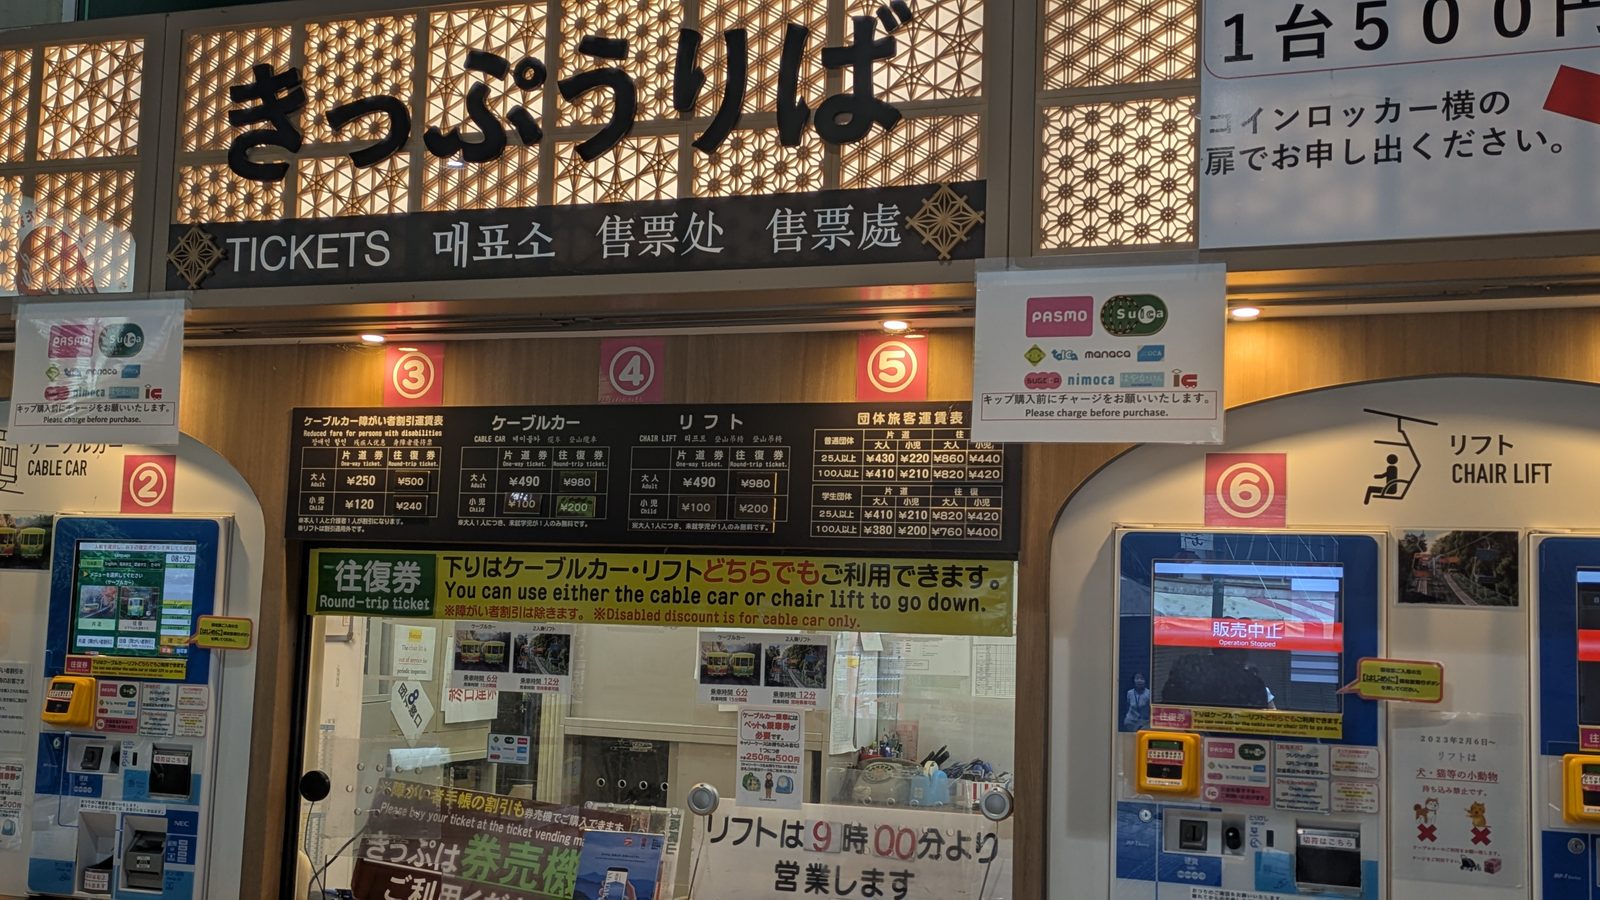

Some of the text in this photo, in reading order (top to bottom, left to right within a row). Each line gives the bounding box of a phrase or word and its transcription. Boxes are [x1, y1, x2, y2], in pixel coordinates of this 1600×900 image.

[227, 0, 903, 181] きっぷうりば
[1209, 90, 1510, 136] コインロッカー横の
[1205, 127, 1563, 176] 扉でお申し出ください。
[226, 202, 902, 272] TICKETS 매표소 售票处 售票處
[1031, 304, 1165, 325] PASMO Suica
[1084, 350, 1131, 360] manaca
[1067, 373, 1115, 386] nimoca
[983, 393, 1210, 405] キップ購入前にチャージをお願いいたします。
[857, 411, 963, 425] 団体旅客運賃表
[1025, 408, 1169, 419] Please charge before purchase.
[43, 416, 142, 425] Please before purchase.
[304, 415, 443, 427] ケーブルカー障がい者割引運賃表
[492, 415, 580, 431] ケーブルカー
[680, 414, 743, 430] リフト
[886, 431, 910, 439] 片道
[824, 436, 854, 445] 普通団体
[874, 441, 890, 449] 大人
[905, 441, 922, 449] 小児
[944, 441, 960, 449] 大人
[1449, 434, 1514, 456] リフト
[342, 450, 384, 459] 片道券
[393, 450, 436, 459] 往復券
[504, 450, 547, 460] 片道券
[558, 450, 603, 460] 往復券
[677, 450, 724, 460] 片道券
[736, 450, 783, 460] 往復券
[821, 454, 856, 463] 25人以上
[866, 453, 1000, 463] ¥430 ¥220 ¥860 ¥440
[27, 459, 88, 476] CABLE CAR
[310, 473, 326, 481] 大人
[470, 474, 487, 482] 大人
[818, 469, 859, 478] 100人以上
[865, 469, 1000, 479] ¥410 ¥210 ¥820 ¥420
[1451, 462, 1553, 484] CHAIR LIFT
[347, 475, 376, 486] ¥250
[398, 478, 423, 486] ¥500
[509, 476, 540, 486] ¥490
[563, 478, 591, 486] ¥980
[641, 474, 659, 483] 大人
[683, 477, 716, 487] ¥490
[741, 479, 770, 488] ¥980
[885, 487, 908, 495] 片道
[954, 488, 979, 496] 往復
[309, 496, 325, 504] 小児
[822, 492, 852, 501] 学生団体
[345, 499, 374, 510] ¥120
[396, 502, 422, 510] ¥240
[469, 498, 485, 506] 小児
[508, 500, 536, 508] ¥100
[561, 503, 588, 511] ¥200
[640, 499, 658, 507] 小児
[873, 498, 888, 506] 大人
[903, 498, 919, 506] 小児
[942, 498, 958, 506] 大人
[973, 498, 990, 506] 小児
[682, 503, 710, 512] ¥100
[739, 504, 768, 513] ¥200
[819, 510, 854, 518] 25人以上
[864, 510, 999, 521] ¥410 ¥210 ¥820 ¥420
[816, 526, 857, 534] 100人以上
[863, 525, 998, 537] ¥380 ¥200 ¥760 ¥400
[170, 554, 191, 563] 08:52
[334, 559, 422, 594] 往復券
[443, 555, 1000, 590] 下りはケーブルカー・リフトどちらでもご利用できます。
[444, 581, 987, 613] You can use either the cable car or chair lift to go down.
[319, 594, 430, 611] Round-trip ticket
[444, 604, 584, 621] ※障がい者割引は除きます。
[664, 610, 861, 629] discount is for cable car only.
[1212, 621, 1283, 640] 販売中止
[1218, 639, 1276, 648] Operation Stopped
[1438, 751, 1478, 762] リフトは
[174, 820, 190, 828] NEC
[379, 802, 409, 816] Please
[411, 806, 426, 823] buy
[426, 810, 449, 825] your
[449, 809, 476, 829] ticket
[477, 817, 487, 830] at
[489, 817, 505, 832] the
[506, 820, 533, 837] ticket
[534, 824, 574, 845] vending
[706, 814, 999, 863] リフトは9時00分より
[774, 860, 915, 900] 営業します
